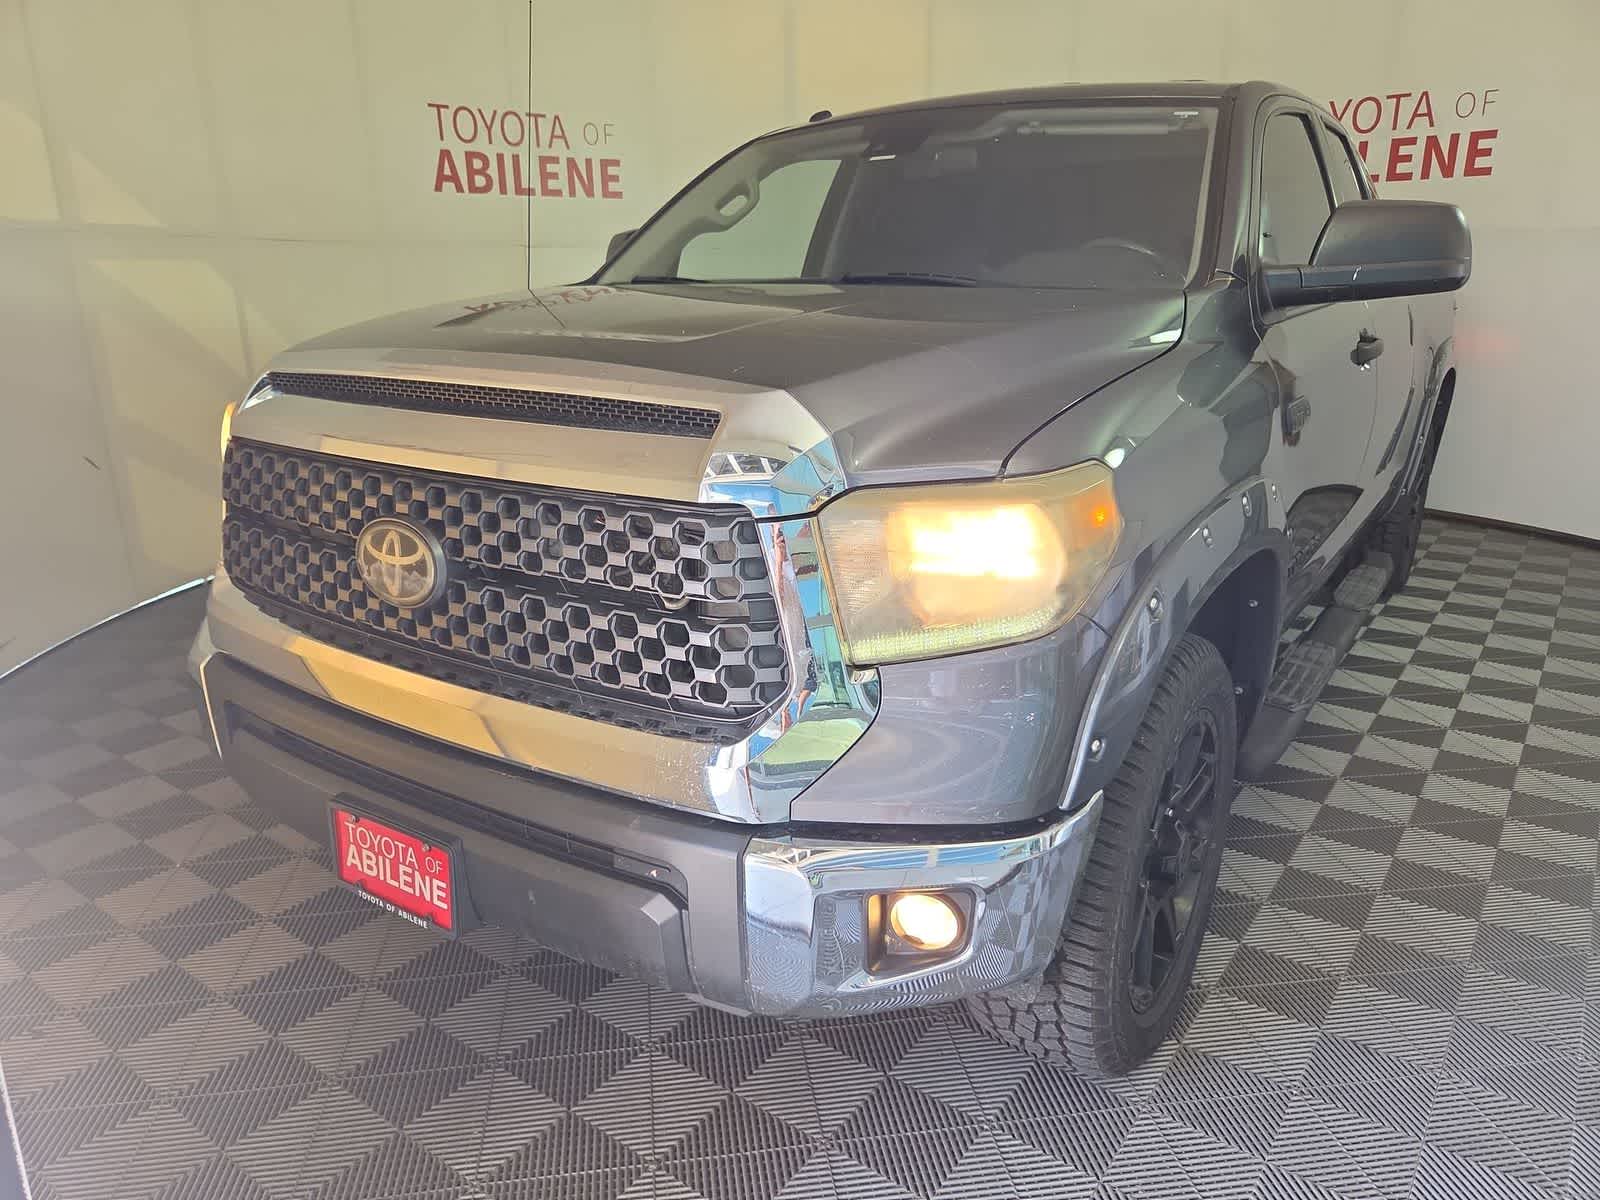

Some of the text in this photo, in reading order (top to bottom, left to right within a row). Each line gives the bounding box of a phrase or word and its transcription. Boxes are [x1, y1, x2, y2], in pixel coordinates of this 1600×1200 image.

[427, 102, 615, 150] TOYOTA OF
[1329, 89, 1499, 134] YOTA OF
[434, 149, 624, 199] ABILENE
[344, 821, 443, 874] TOYOTA OF
[346, 844, 448, 910] ABILENE
[358, 890, 428, 928] TOYOTA OF ABILENE
